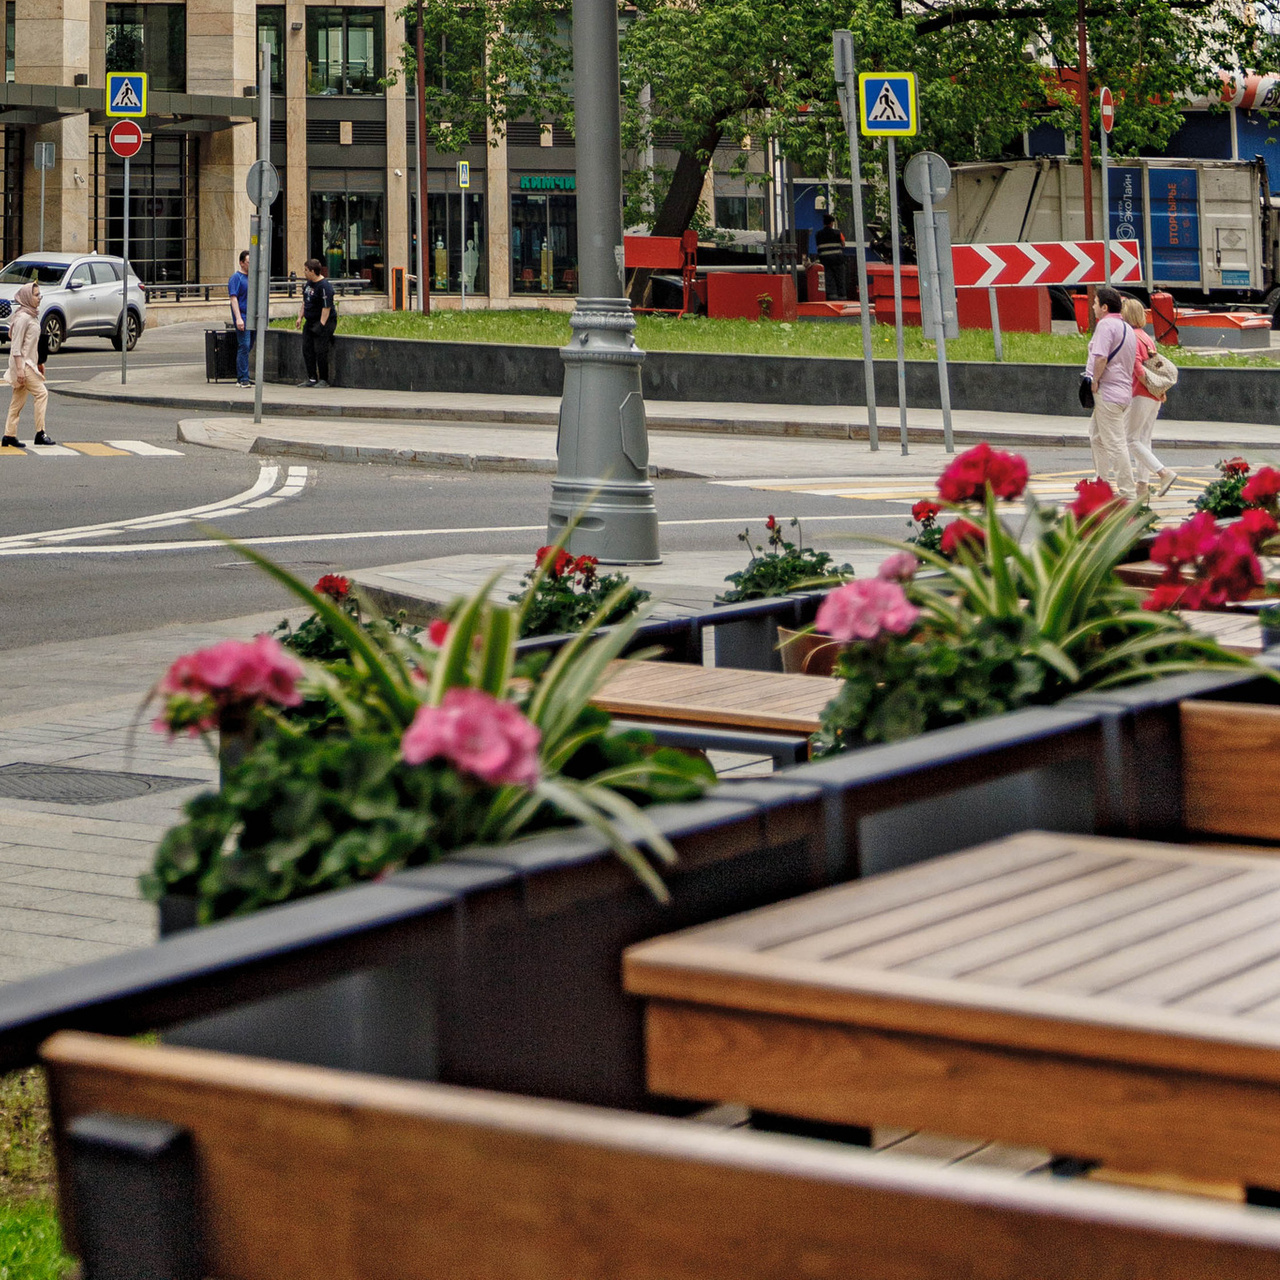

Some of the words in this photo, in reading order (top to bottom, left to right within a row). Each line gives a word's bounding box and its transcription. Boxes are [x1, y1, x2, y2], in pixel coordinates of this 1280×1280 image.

[520, 176, 576, 189] КИМЧИ
[1123, 174, 1133, 222] ЭкоЛайн
[1168, 183, 1179, 244] ВТОРСЫРЬЕ
